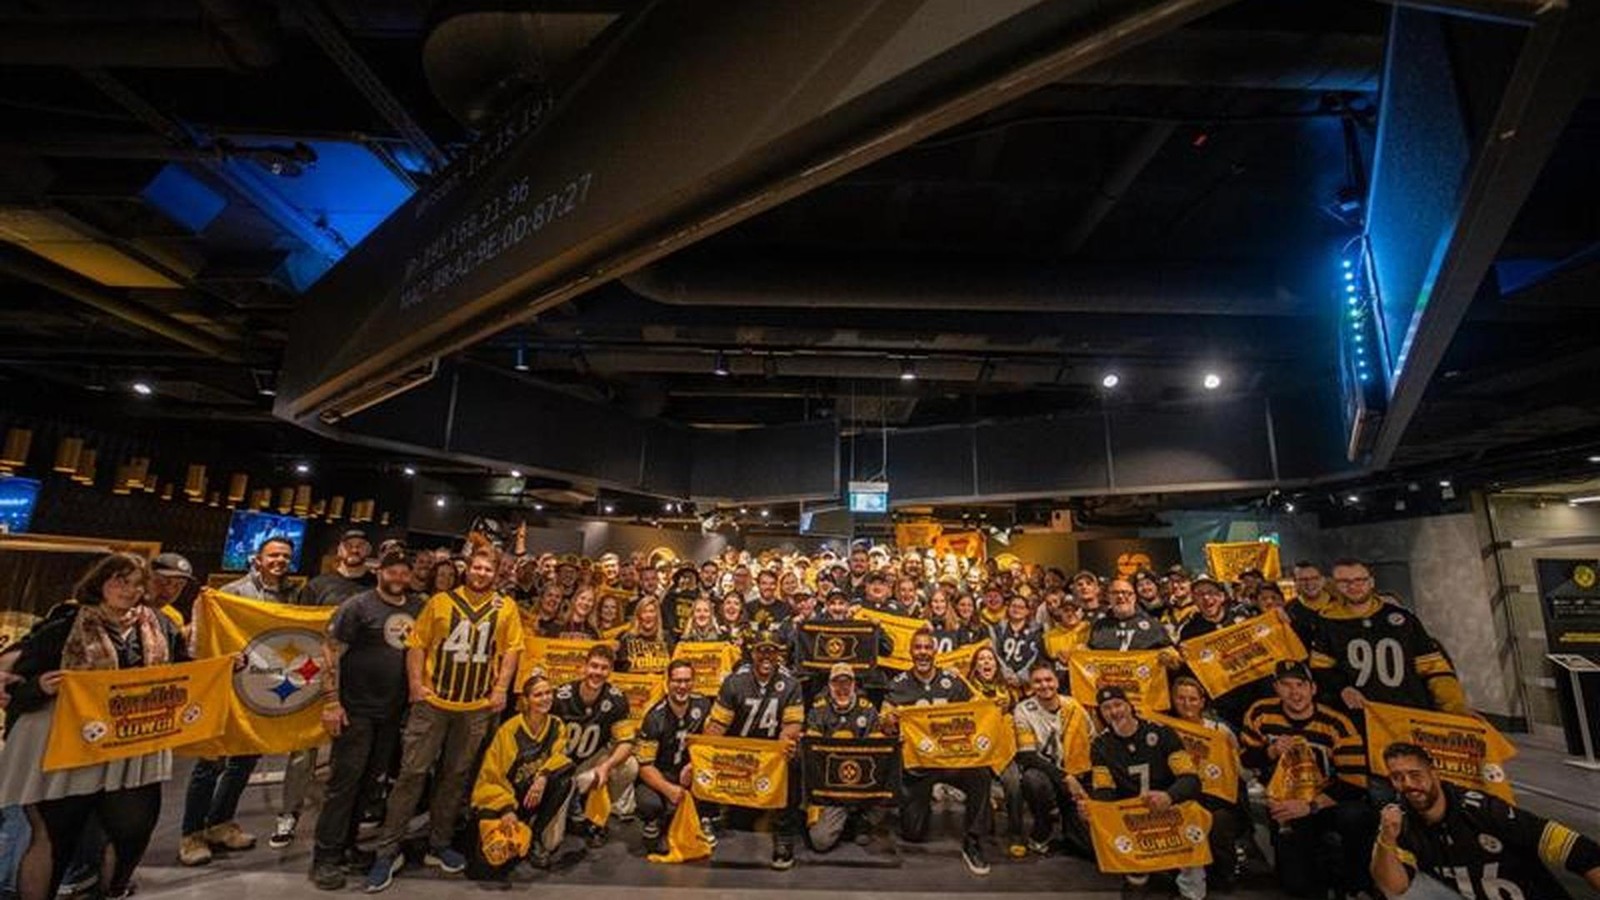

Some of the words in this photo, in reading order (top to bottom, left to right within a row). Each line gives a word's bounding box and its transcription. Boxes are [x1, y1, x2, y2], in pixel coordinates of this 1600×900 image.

[444, 619, 492, 663] 41
[1347, 637, 1404, 687] 90
[743, 698, 778, 737] 74
[566, 722, 600, 758] 90
[1127, 764, 1149, 796] 7
